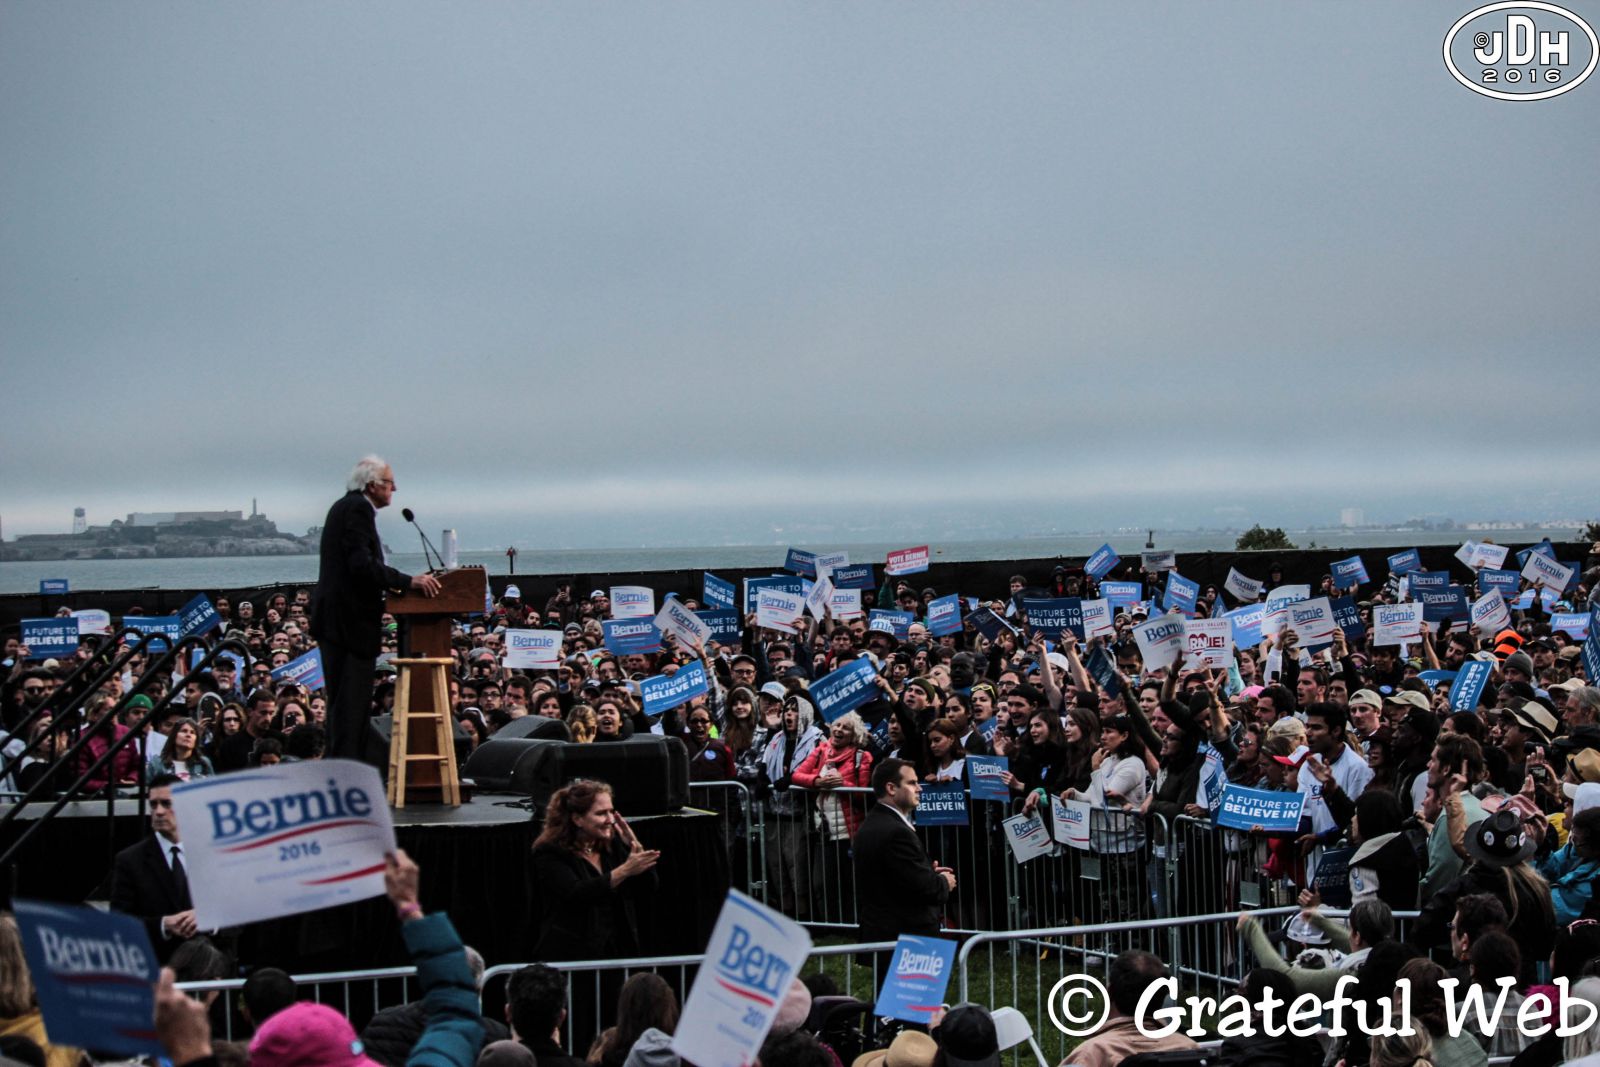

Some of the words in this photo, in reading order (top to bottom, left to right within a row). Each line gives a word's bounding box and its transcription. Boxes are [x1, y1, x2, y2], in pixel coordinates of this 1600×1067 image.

[889, 554, 904, 564] VOTE
[905, 550, 926, 562] BERNIE
[838, 568, 868, 580] Bernie
[1534, 557, 1564, 580] Bernie
[1231, 574, 1258, 592] Bernie
[1412, 574, 1444, 585] Bernie
[1484, 573, 1514, 583] Bernie
[789, 584, 800, 592] TO
[1106, 585, 1137, 594] Bernie
[1169, 579, 1194, 600] Bernie
[614, 592, 650, 603] Bernie
[761, 593, 797, 611] Bernie
[833, 593, 855, 603] rnie
[1422, 592, 1458, 604] Bernie
[203, 607, 215, 618] IN
[1033, 608, 1065, 617] FUTURE
[1067, 608, 1080, 616] TO
[1293, 606, 1324, 622] Bernie
[1344, 606, 1355, 615] TO
[1380, 609, 1415, 623] Bernie
[669, 605, 702, 637] Bernie
[1029, 617, 1067, 627] BELIEVE
[1069, 617, 1081, 626] IN
[1347, 615, 1359, 626] IN
[24, 628, 31, 636] A
[32, 626, 64, 636] FUTURE
[66, 626, 77, 635] TO
[610, 622, 652, 637] Bernie
[727, 625, 737, 633] IN
[24, 636, 64, 645] BELIEVE
[66, 635, 78, 645] IN
[512, 635, 554, 648] Bernie
[280, 658, 318, 678] Bernie
[651, 675, 687, 692] FUTURE
[688, 669, 702, 678] TO
[816, 690, 823, 700] A
[823, 672, 858, 694] FUTURE
[858, 666, 873, 676] TO
[645, 682, 689, 702] BELIEVE
[690, 676, 703, 686] IN
[819, 680, 863, 710] BELIEVE
[1463, 674, 1481, 710] FUTUR
[972, 761, 1002, 776] Bernie
[921, 792, 952, 801] FUTURE
[952, 792, 964, 801] TO
[1226, 794, 1234, 802] A
[1236, 796, 1282, 809] FUTURE
[1284, 801, 1300, 809] TO
[207, 778, 372, 841] Bernie
[954, 801, 965, 810] IN
[1055, 803, 1083, 822] Bernie
[1223, 802, 1280, 819] BELIEVE
[1282, 809, 1298, 819] IN
[278, 840, 322, 861] 2016
[38, 925, 149, 979] Bernie
[897, 948, 944, 976] Bernie
[742, 1006, 767, 1031] 201
